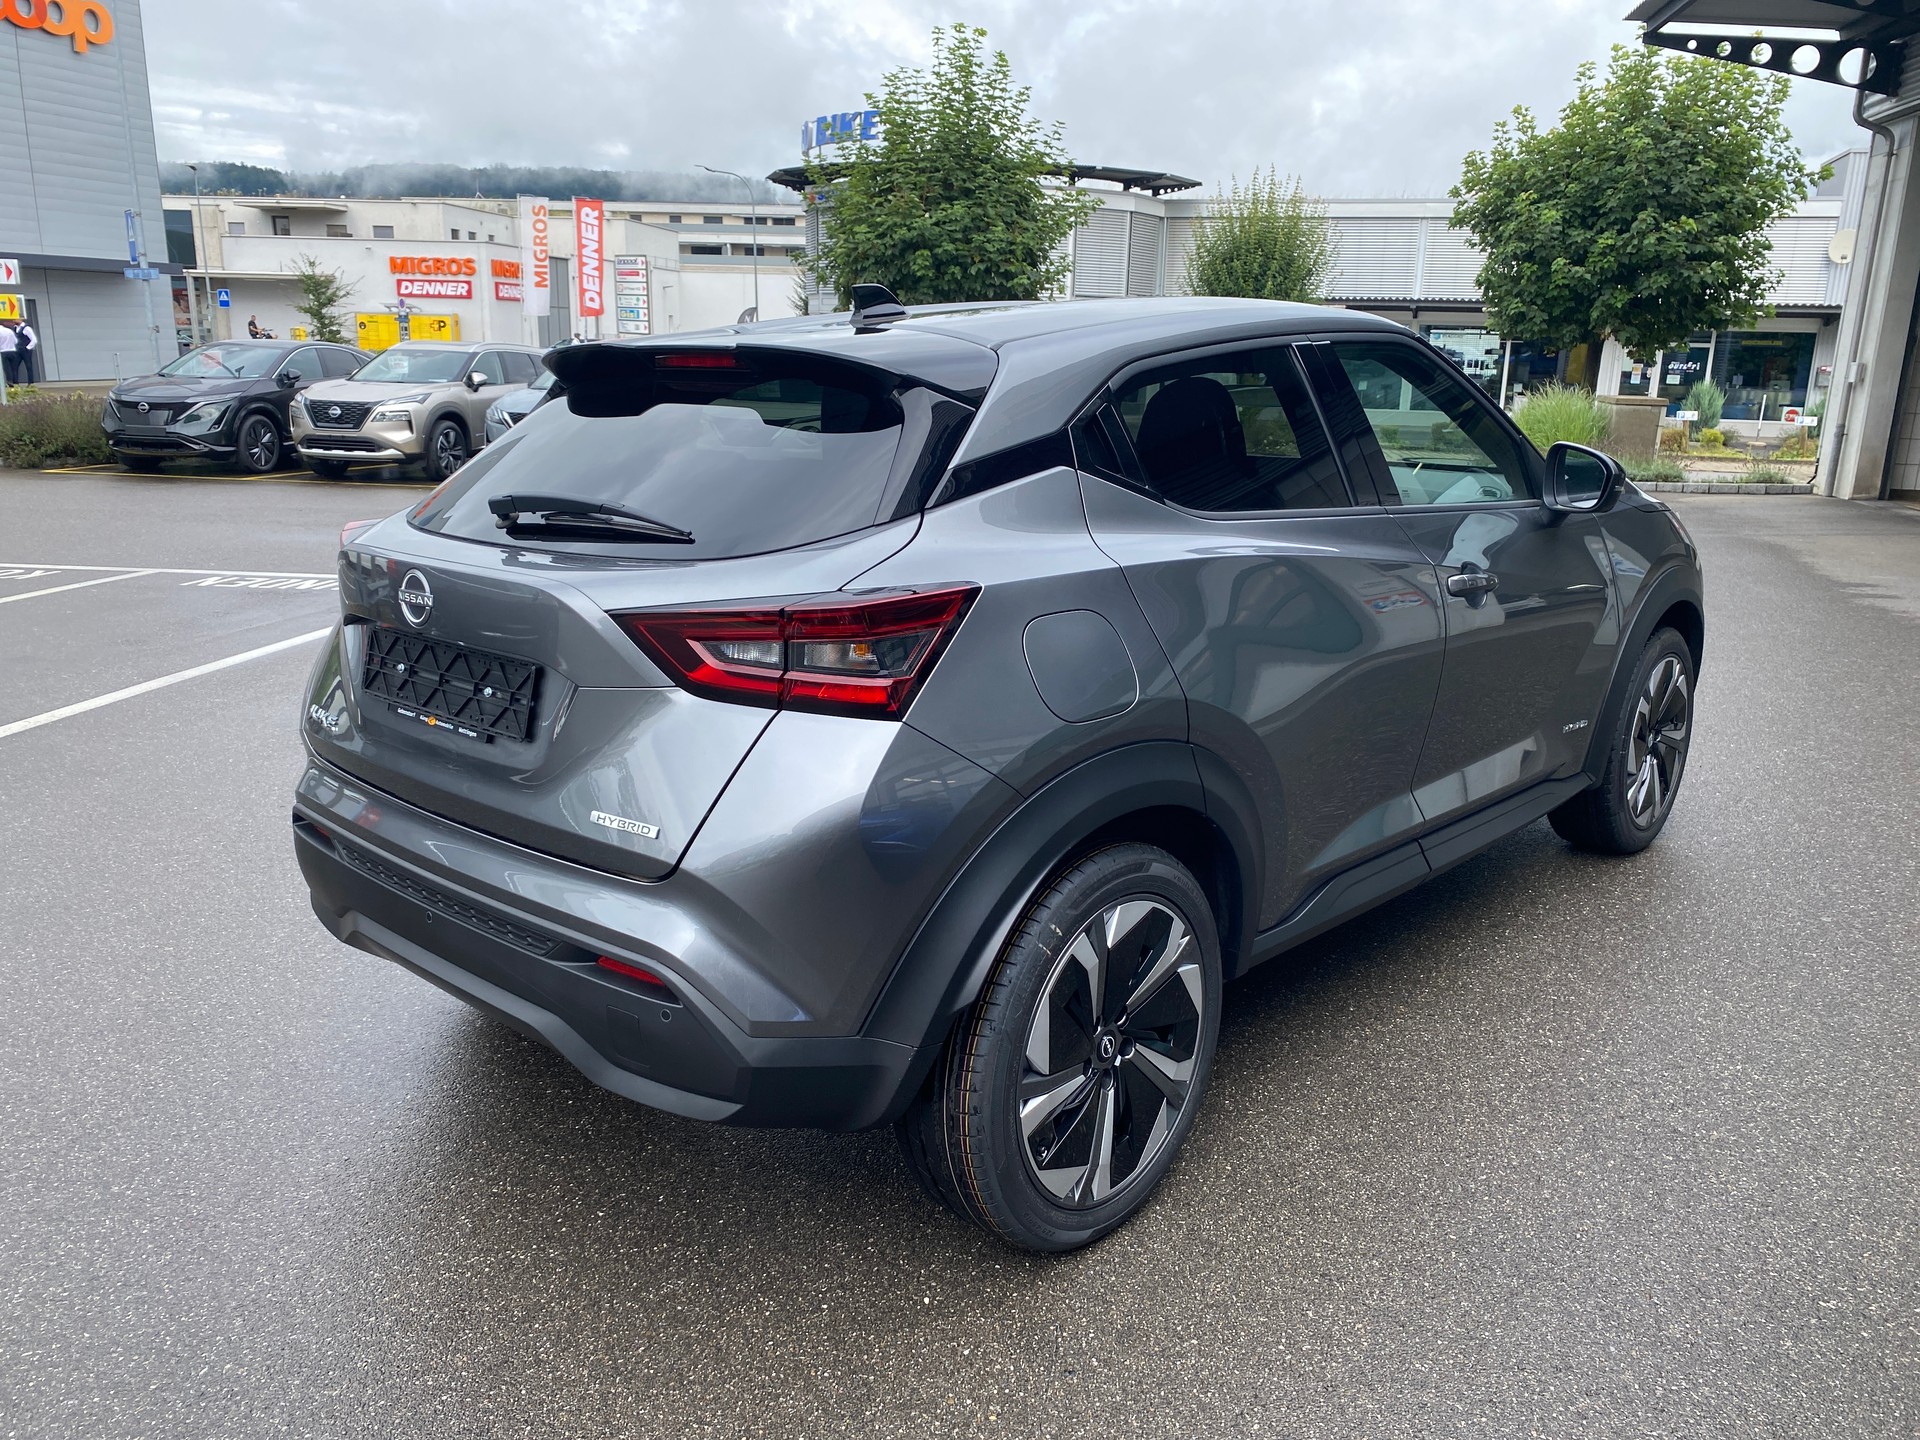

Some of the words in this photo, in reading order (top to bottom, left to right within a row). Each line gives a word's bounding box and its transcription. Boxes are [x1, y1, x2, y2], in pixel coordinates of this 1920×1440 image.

[0, 0, 114, 53] oop
[531, 204, 549, 288] MIGROS
[389, 256, 477, 276] MIGROS
[580, 206, 601, 309] DENNER
[400, 280, 469, 296] DENNER
[499, 285, 521, 298] DENNE
[398, 590, 433, 606] NISSAN
[596, 814, 651, 835] HYBRID
